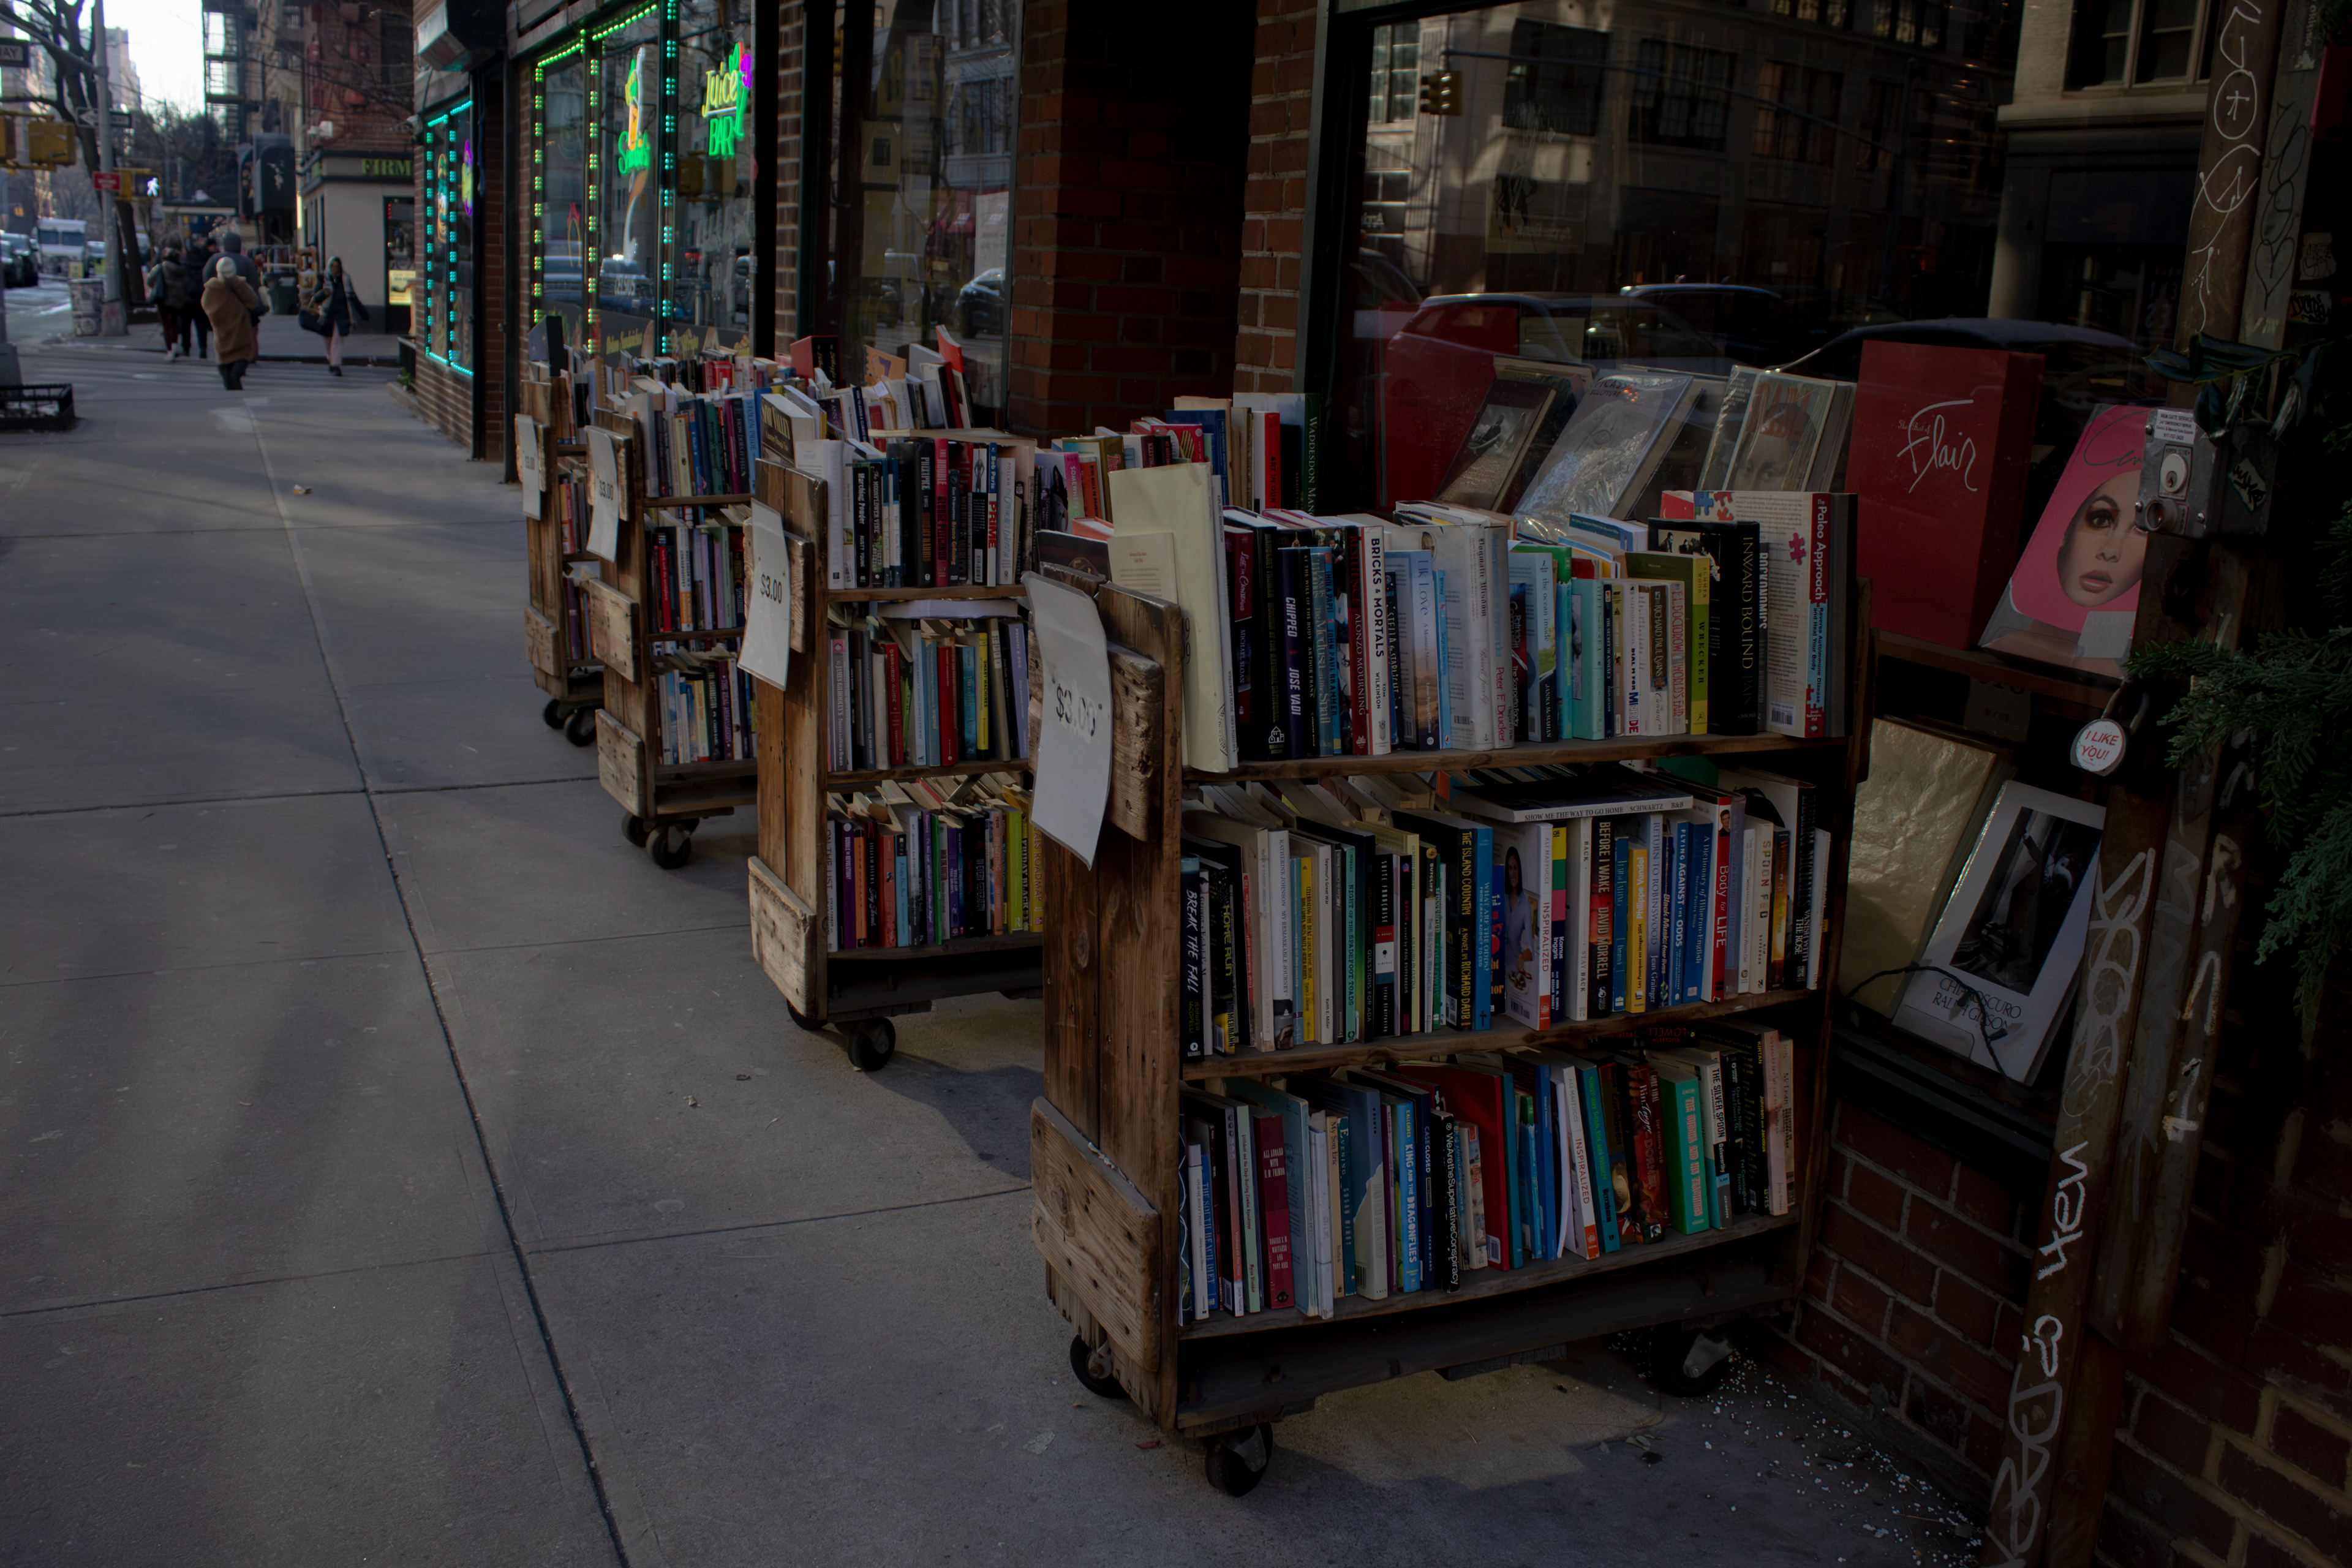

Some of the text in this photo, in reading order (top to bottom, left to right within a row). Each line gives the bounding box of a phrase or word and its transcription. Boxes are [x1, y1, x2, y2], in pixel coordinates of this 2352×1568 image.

[0, 47, 19, 58] AY
[702, 61, 737, 118] Juice
[709, 116, 735, 159] BAR
[361, 159, 411, 176] FIRM
[747, 401, 755, 428] STOLEN
[1308, 417, 1317, 483] WADDESDON
[1897, 399, 1977, 493] Flair
[598, 480, 613, 501] $3.00
[937, 459, 947, 485] DOUBLE
[1070, 466, 1079, 509] SOMEWHERE
[937, 496, 947, 522] GEORGE
[1813, 506, 1827, 600] Paleo Approach
[760, 573, 783, 604] $3.00
[1371, 538, 1384, 657] BRICKS MORTALS
[1741, 537, 1754, 668] INWARD BOUND
[1286, 597, 1297, 637] CHIPPED
[1655, 605, 1664, 636] RICHARD
[1316, 620, 1330, 723] Medusa Snail
[1354, 613, 1366, 715] ALONZO MOURNING
[1655, 656, 1664, 676] EVANS
[1291, 694, 1301, 715] VADI
[1496, 667, 1507, 741] Peter Drucker
[1673, 701, 1684, 717] FAIR
[723, 707, 732, 742] AMBASSADORS
[2085, 730, 2119, 745] I LIKE
[2081, 746, 2109, 760] YOU!
[1630, 803, 1664, 812] SCHWARTZ
[1461, 832, 1472, 915] THE ISLAND COUNTRY
[1597, 821, 1610, 893] BEFORE WAKE
[1653, 862, 1659, 875] TO
[1677, 863, 1686, 905] AGAINST
[1760, 841, 1771, 919] SPOON FED
[1223, 905, 1232, 944] HOME
[1281, 911, 1286, 921] MY
[1716, 865, 1729, 948] Body LIFE
[1186, 889, 1199, 993] BREAK THE FALL
[1597, 907, 1609, 979] DAVID MORRELL
[1461, 961, 1471, 996] RICHARD
[1461, 998, 1470, 1019] DAUB
[1648, 1028, 1687, 1038] LOWELL
[1650, 1075, 1659, 1102] GORE VIDAL
[1712, 1068, 1725, 1137] THE SILVER SPOON
[1611, 1093, 1622, 1145] Caribbean
[1405, 1144, 1414, 1167] KING
[1575, 1139, 1590, 1204] INSPIRALIZED
[1684, 1097, 1703, 1216] THE BUDDHA AND HIS TEACHINGS
[1602, 1188, 1612, 1222] Berenbaum
[1407, 1196, 1417, 1263] DRAGONFLIES
